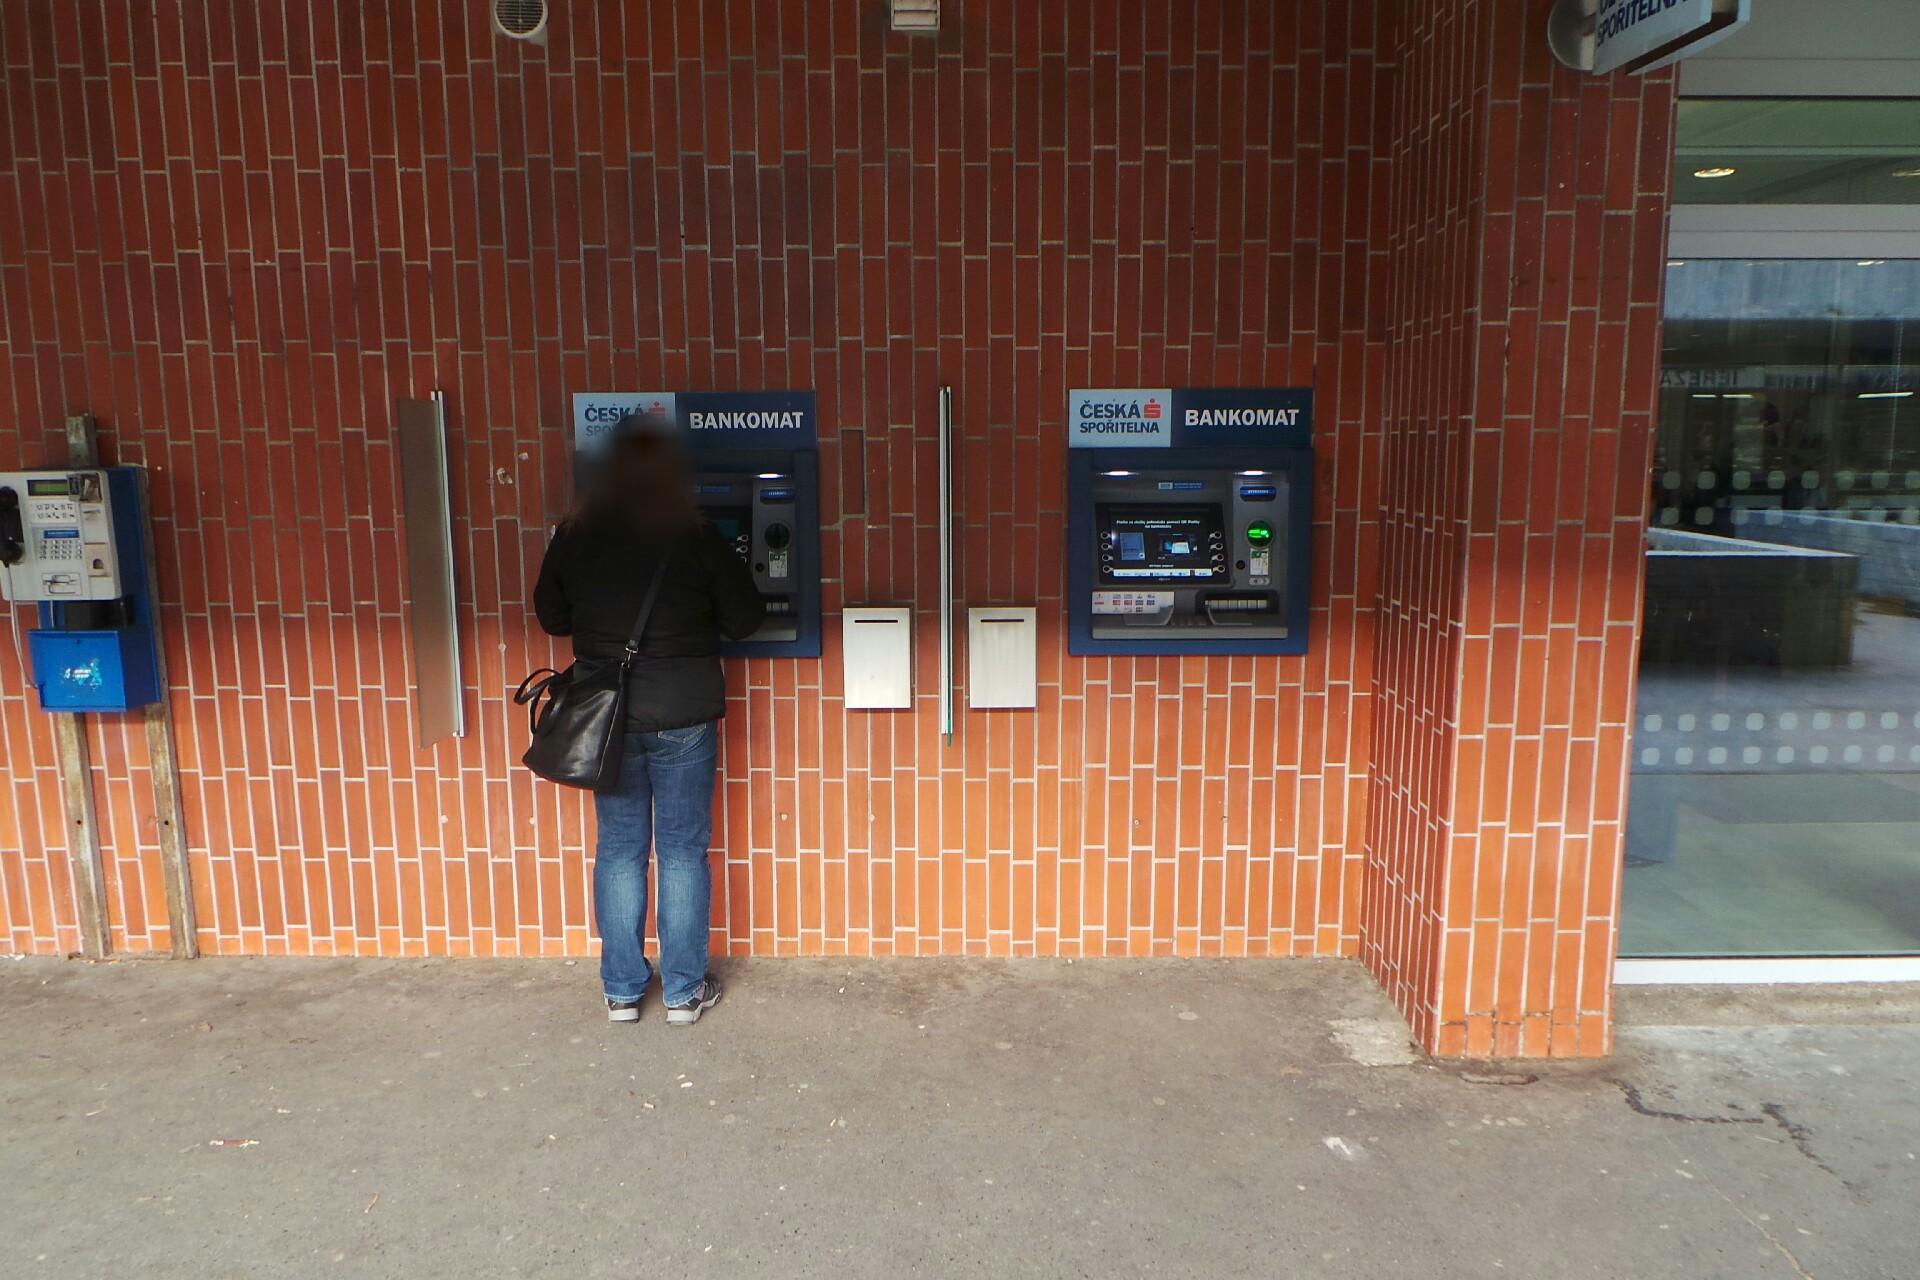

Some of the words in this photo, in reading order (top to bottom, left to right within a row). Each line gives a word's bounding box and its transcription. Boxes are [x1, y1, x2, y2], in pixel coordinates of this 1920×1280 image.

[1080, 400, 1141, 419] ČESKÁ
[1185, 408, 1300, 426] BANKOMAT
[689, 411, 804, 429] BANKOMAT
[1080, 421, 1160, 433] SPOŘITELNA
